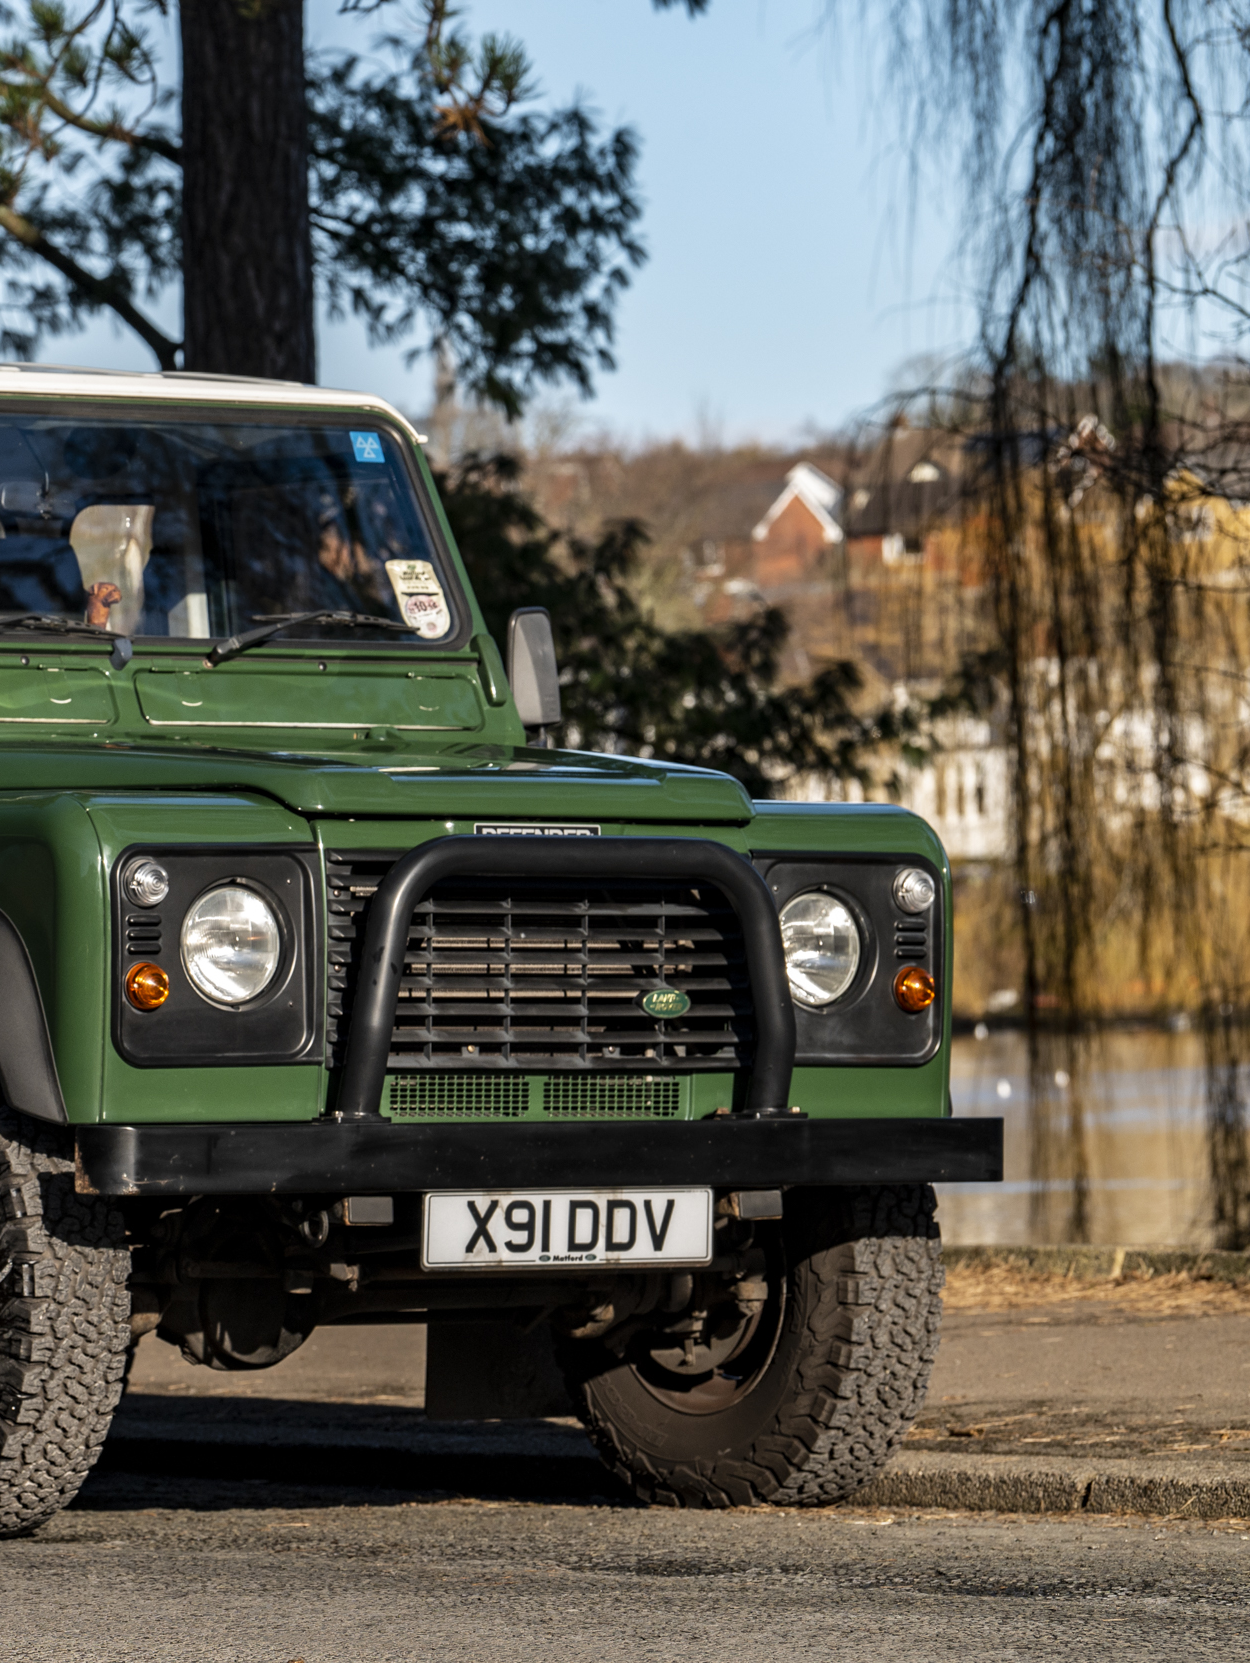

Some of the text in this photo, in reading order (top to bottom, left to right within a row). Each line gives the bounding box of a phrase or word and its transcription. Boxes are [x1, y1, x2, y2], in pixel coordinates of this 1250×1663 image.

[464, 1199, 675, 1254] X91 DDV
[552, 1254, 583, 1262] Matford
